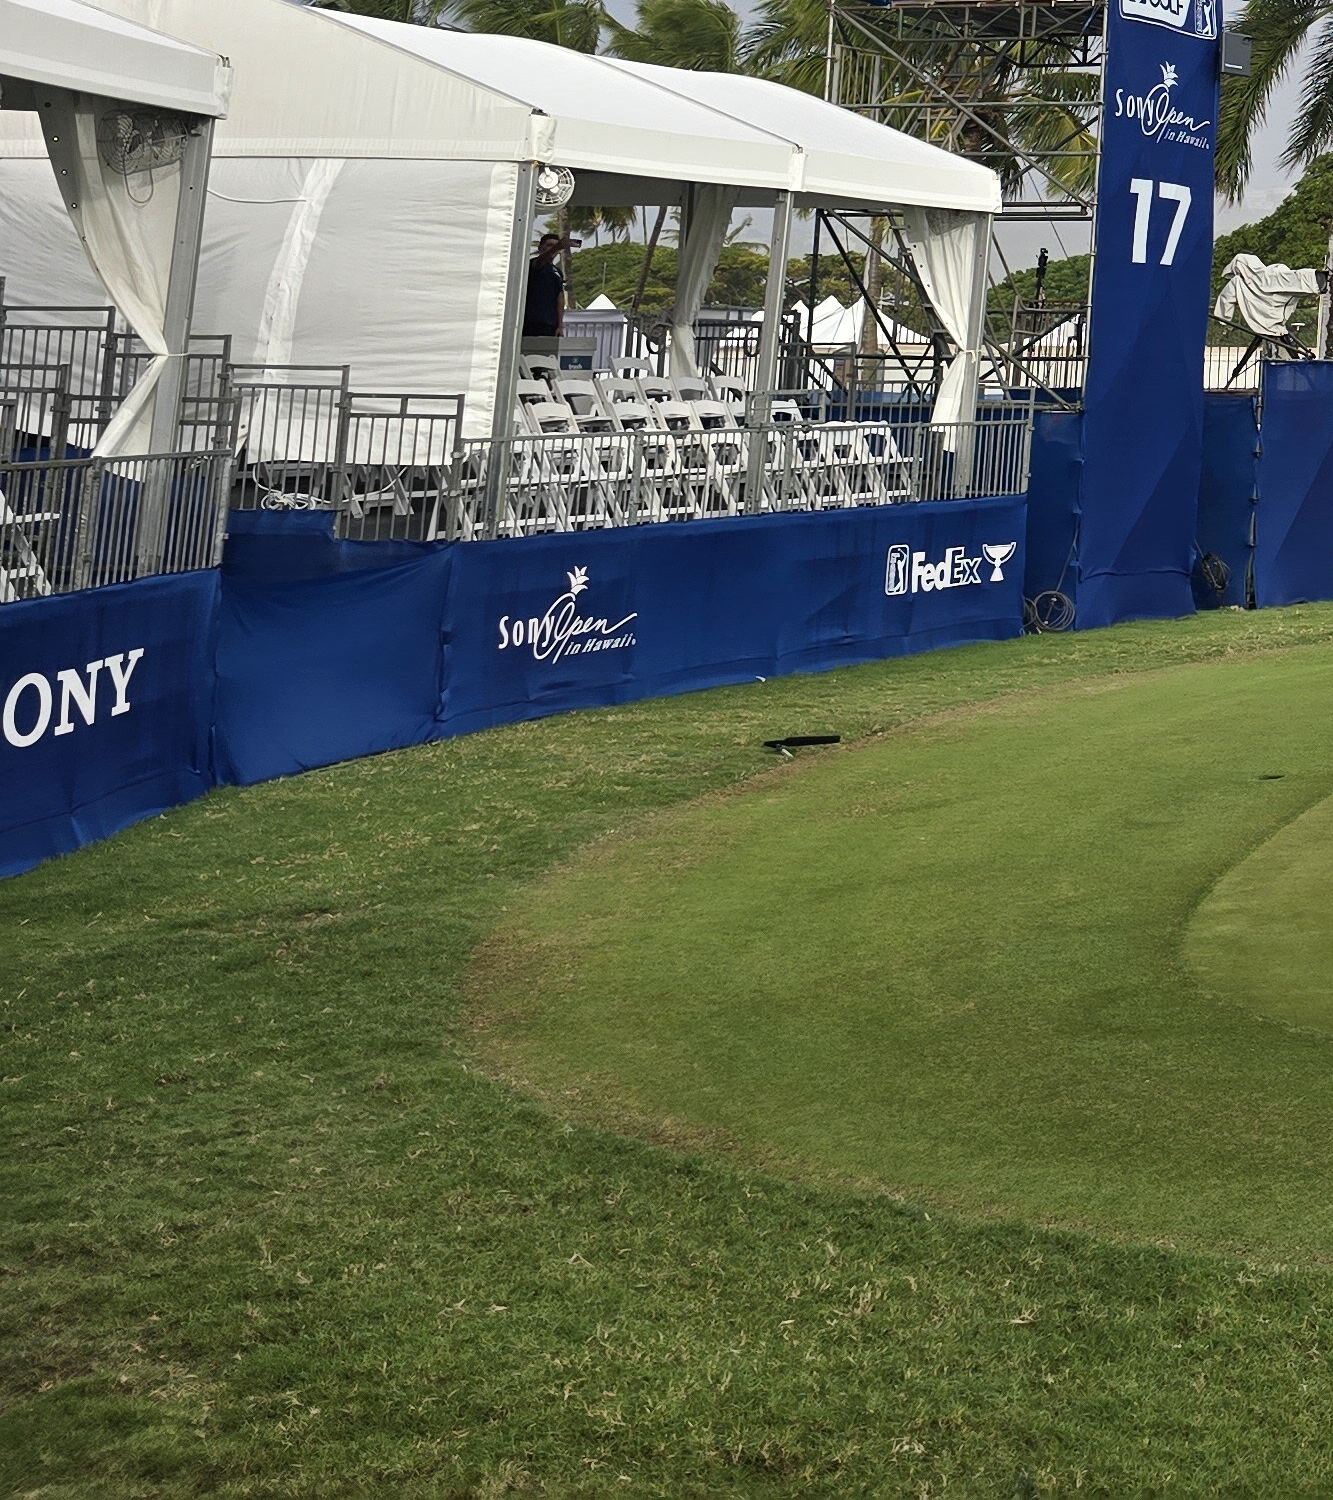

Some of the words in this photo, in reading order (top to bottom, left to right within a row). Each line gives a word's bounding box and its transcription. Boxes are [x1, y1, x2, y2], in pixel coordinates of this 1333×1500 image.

[1141, 83, 1211, 143] Open
[1164, 129, 1175, 141] in
[1175, 130, 1208, 149] Hawaii
[1130, 178, 1192, 266] 17
[911, 546, 983, 593] FedEx
[533, 592, 638, 664] Open
[564, 641, 582, 656] in
[581, 633, 634, 653] Hawaii
